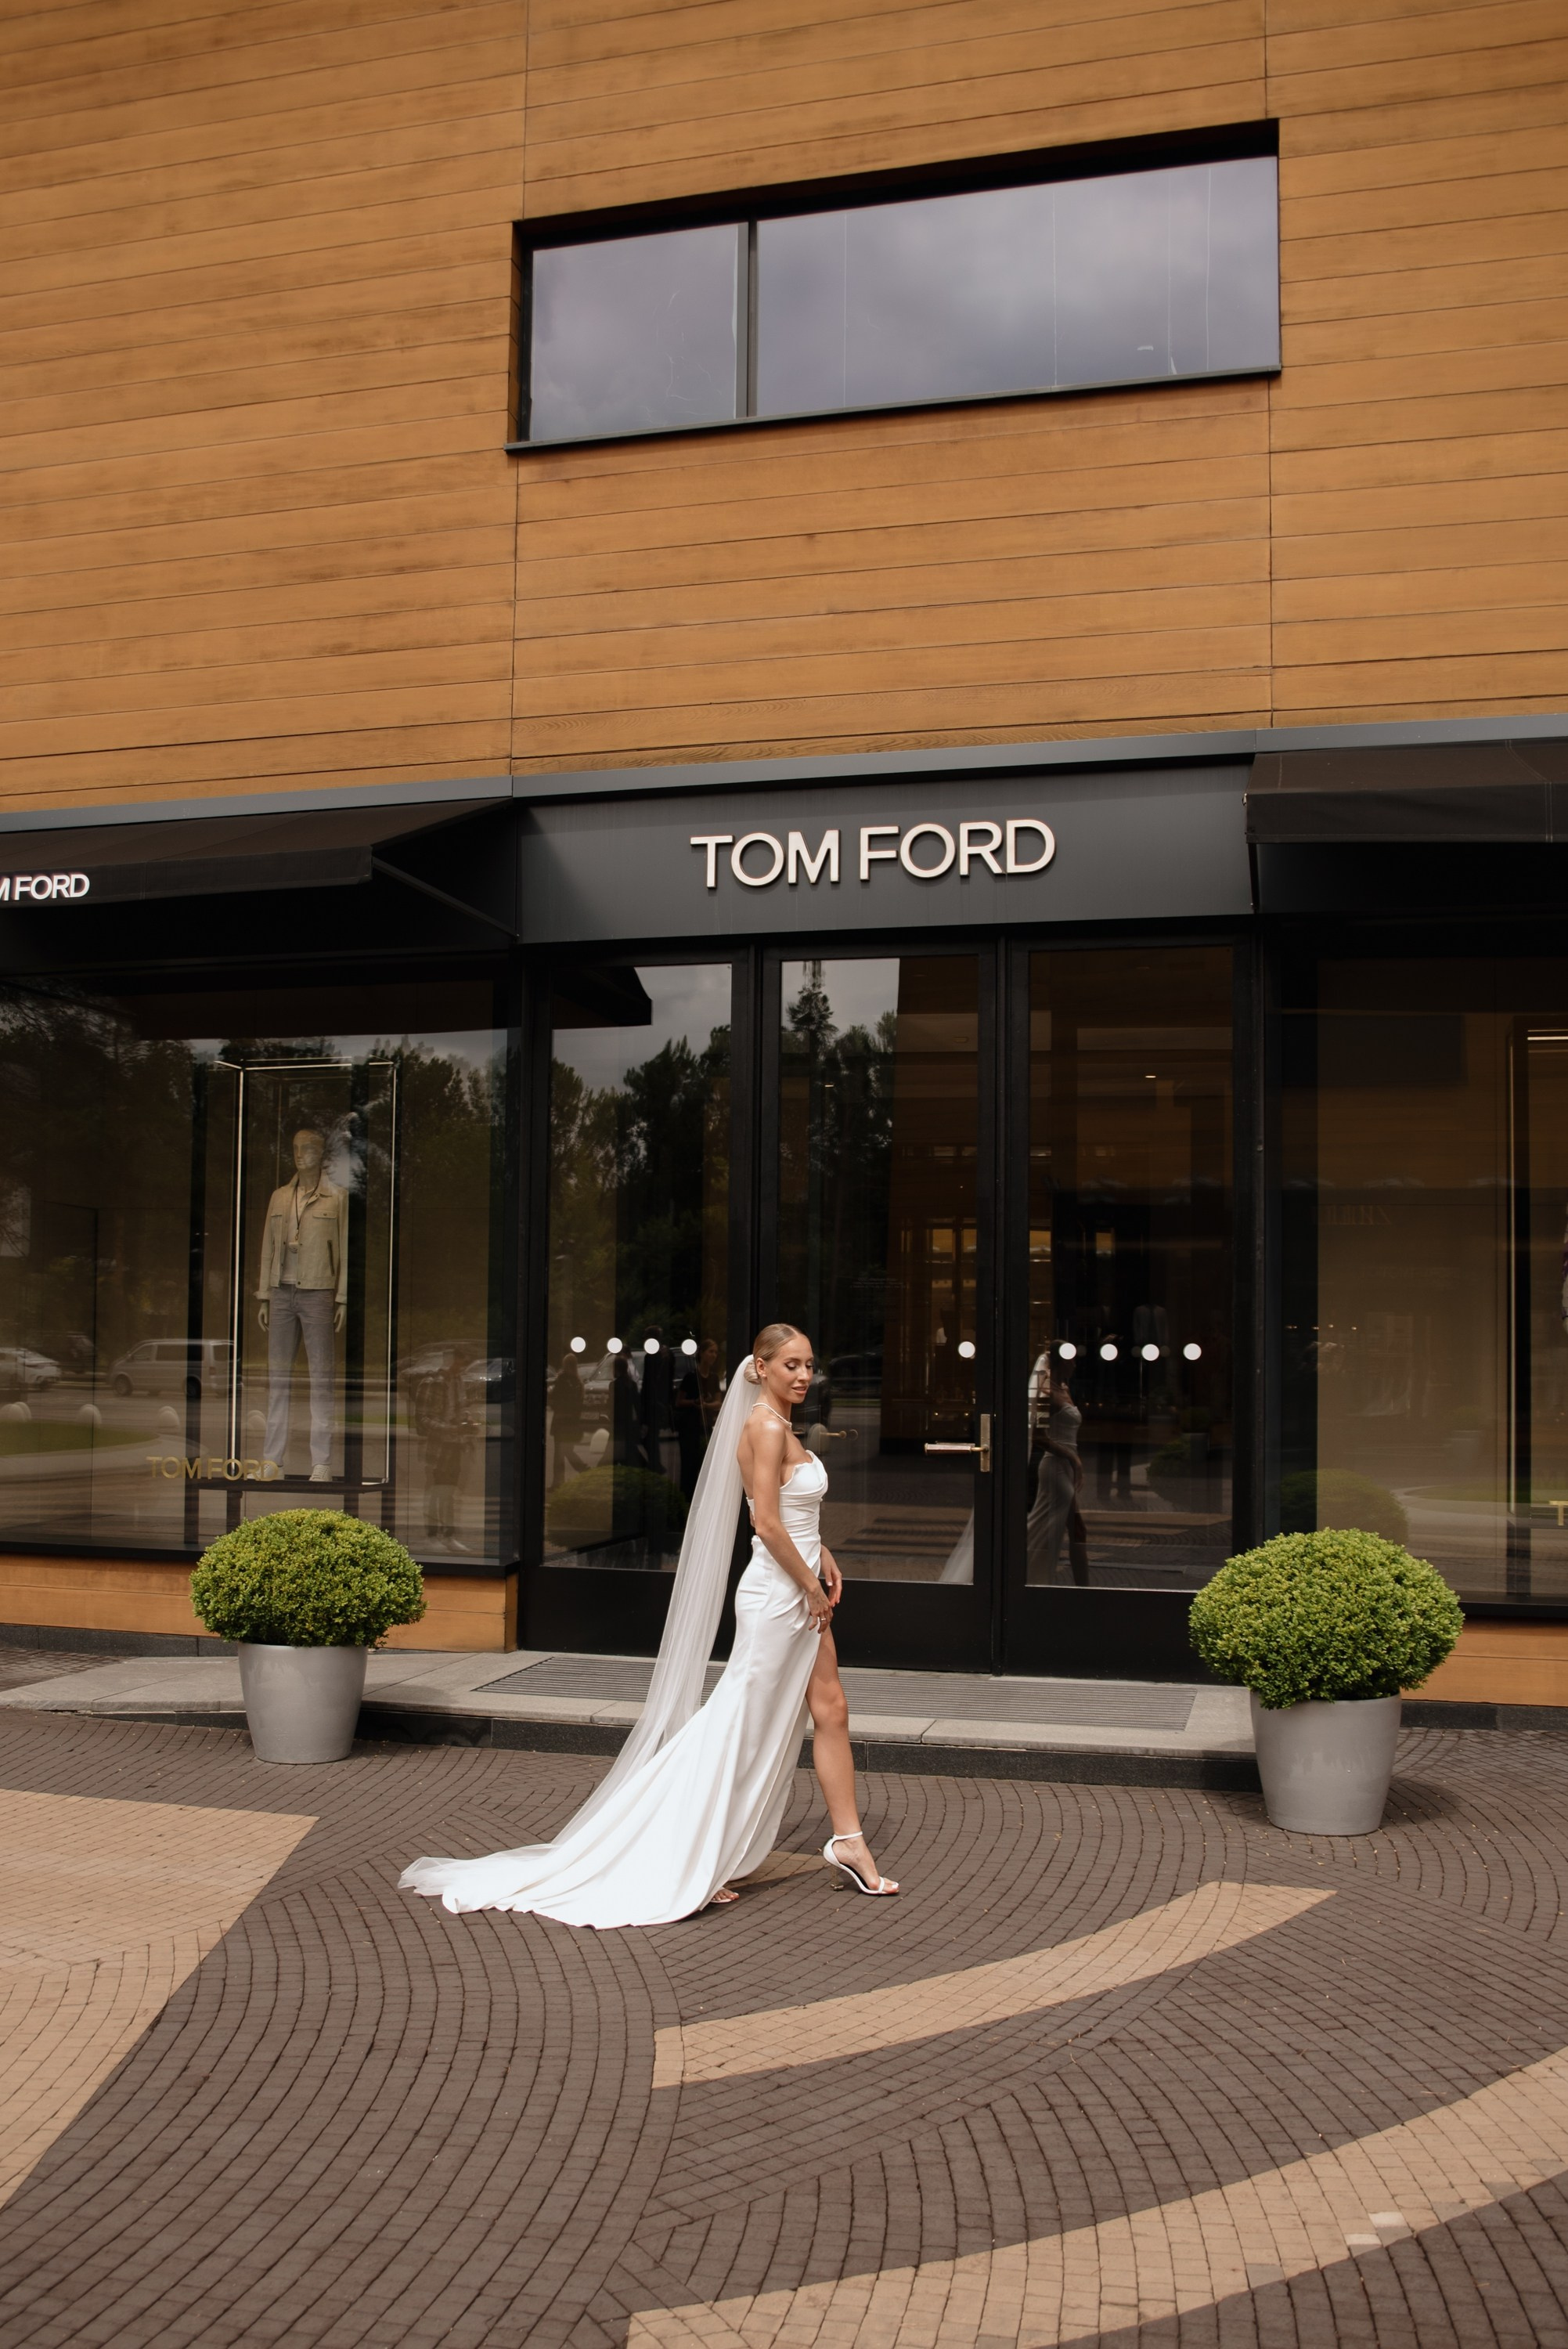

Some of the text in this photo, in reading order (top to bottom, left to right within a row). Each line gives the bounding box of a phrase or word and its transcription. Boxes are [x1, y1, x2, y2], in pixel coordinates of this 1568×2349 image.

[690, 818, 1056, 889] TOM FORD
[14, 874, 90, 900] FORD
[146, 1457, 279, 1481] TOM FORD
